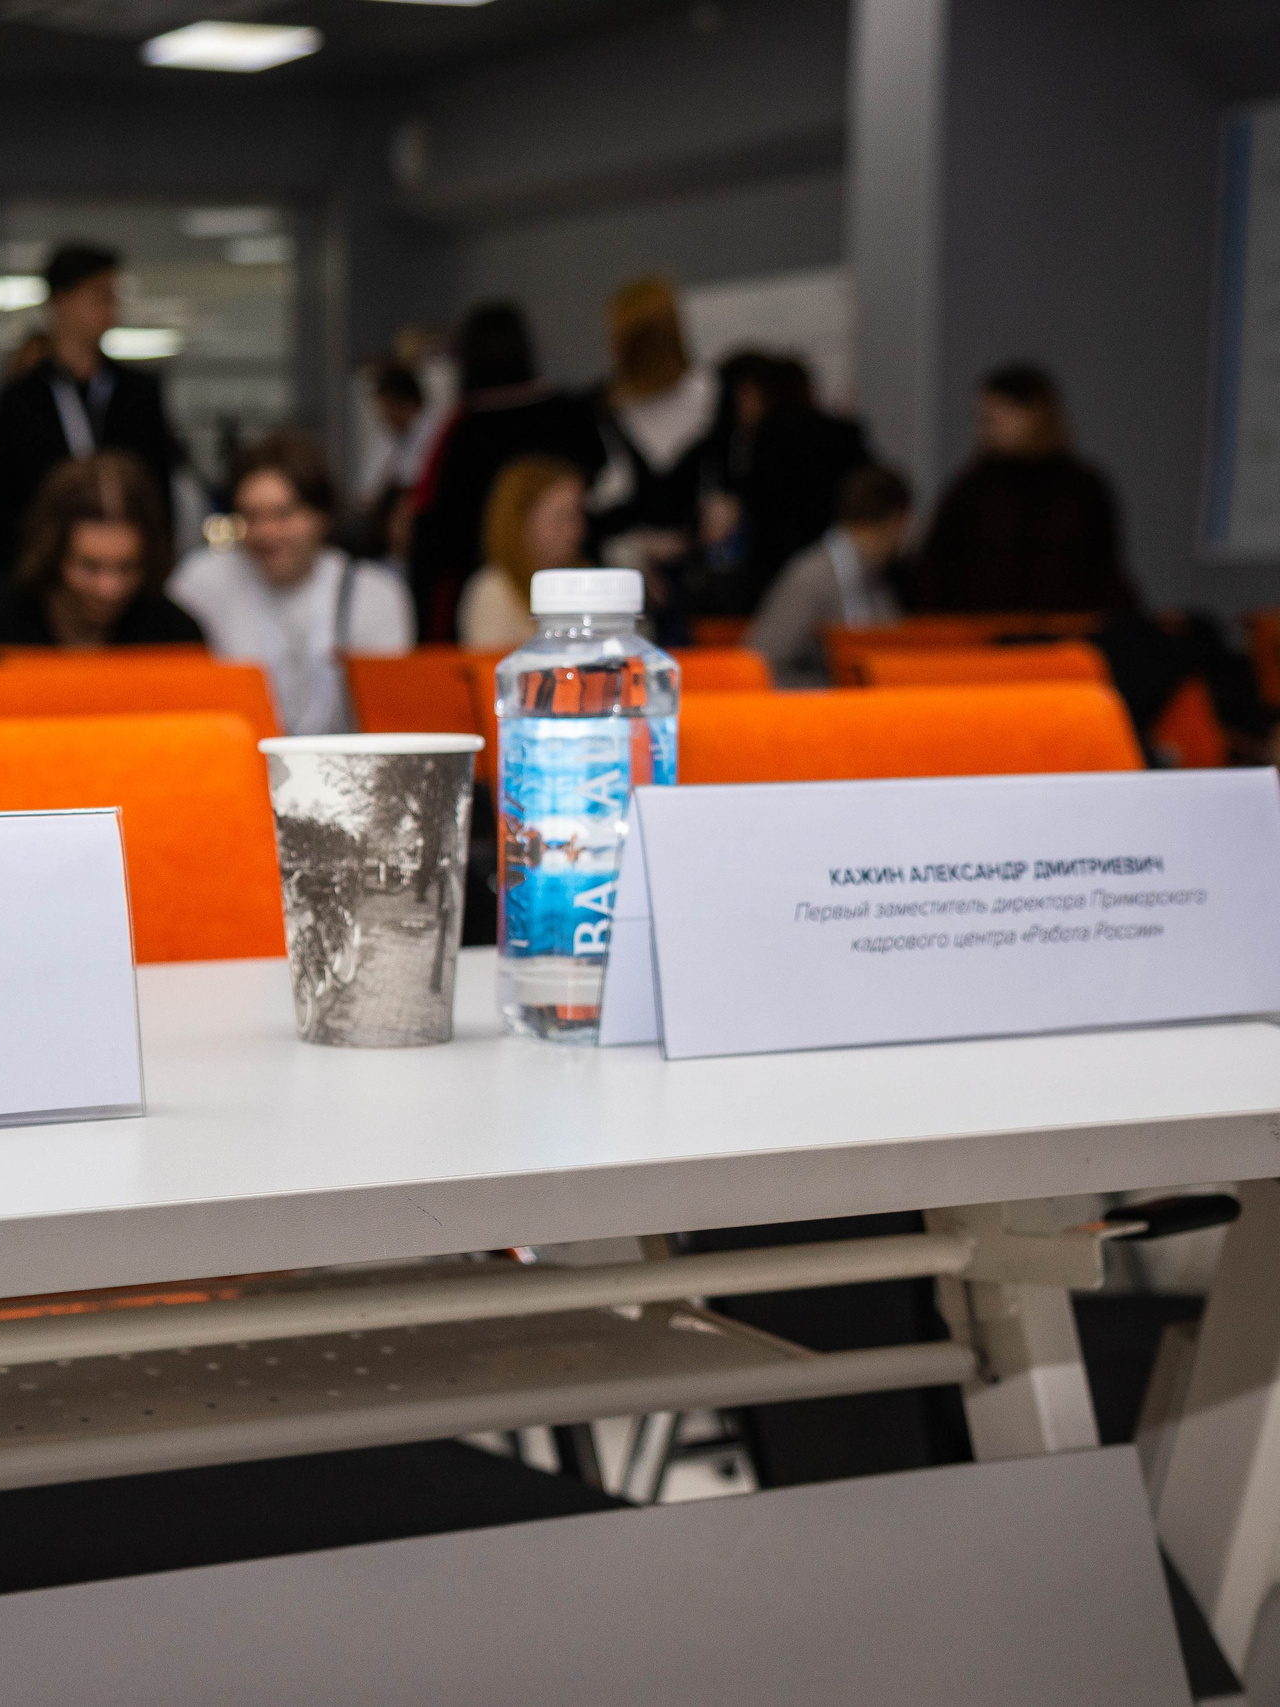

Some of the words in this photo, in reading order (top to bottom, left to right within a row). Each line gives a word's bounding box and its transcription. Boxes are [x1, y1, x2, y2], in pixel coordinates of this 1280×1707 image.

[828, 866, 904, 886] КАЖИН
[909, 860, 1028, 884] АЛЕКСАНДР
[1033, 855, 1165, 882] ДМИТРИЕВИЧ
[794, 900, 869, 923] Первый
[874, 897, 988, 918] заместитель
[989, 893, 1087, 916] директора
[1089, 887, 1207, 911] Приморского
[850, 932, 949, 954] кадрового
[952, 928, 1018, 949] центра
